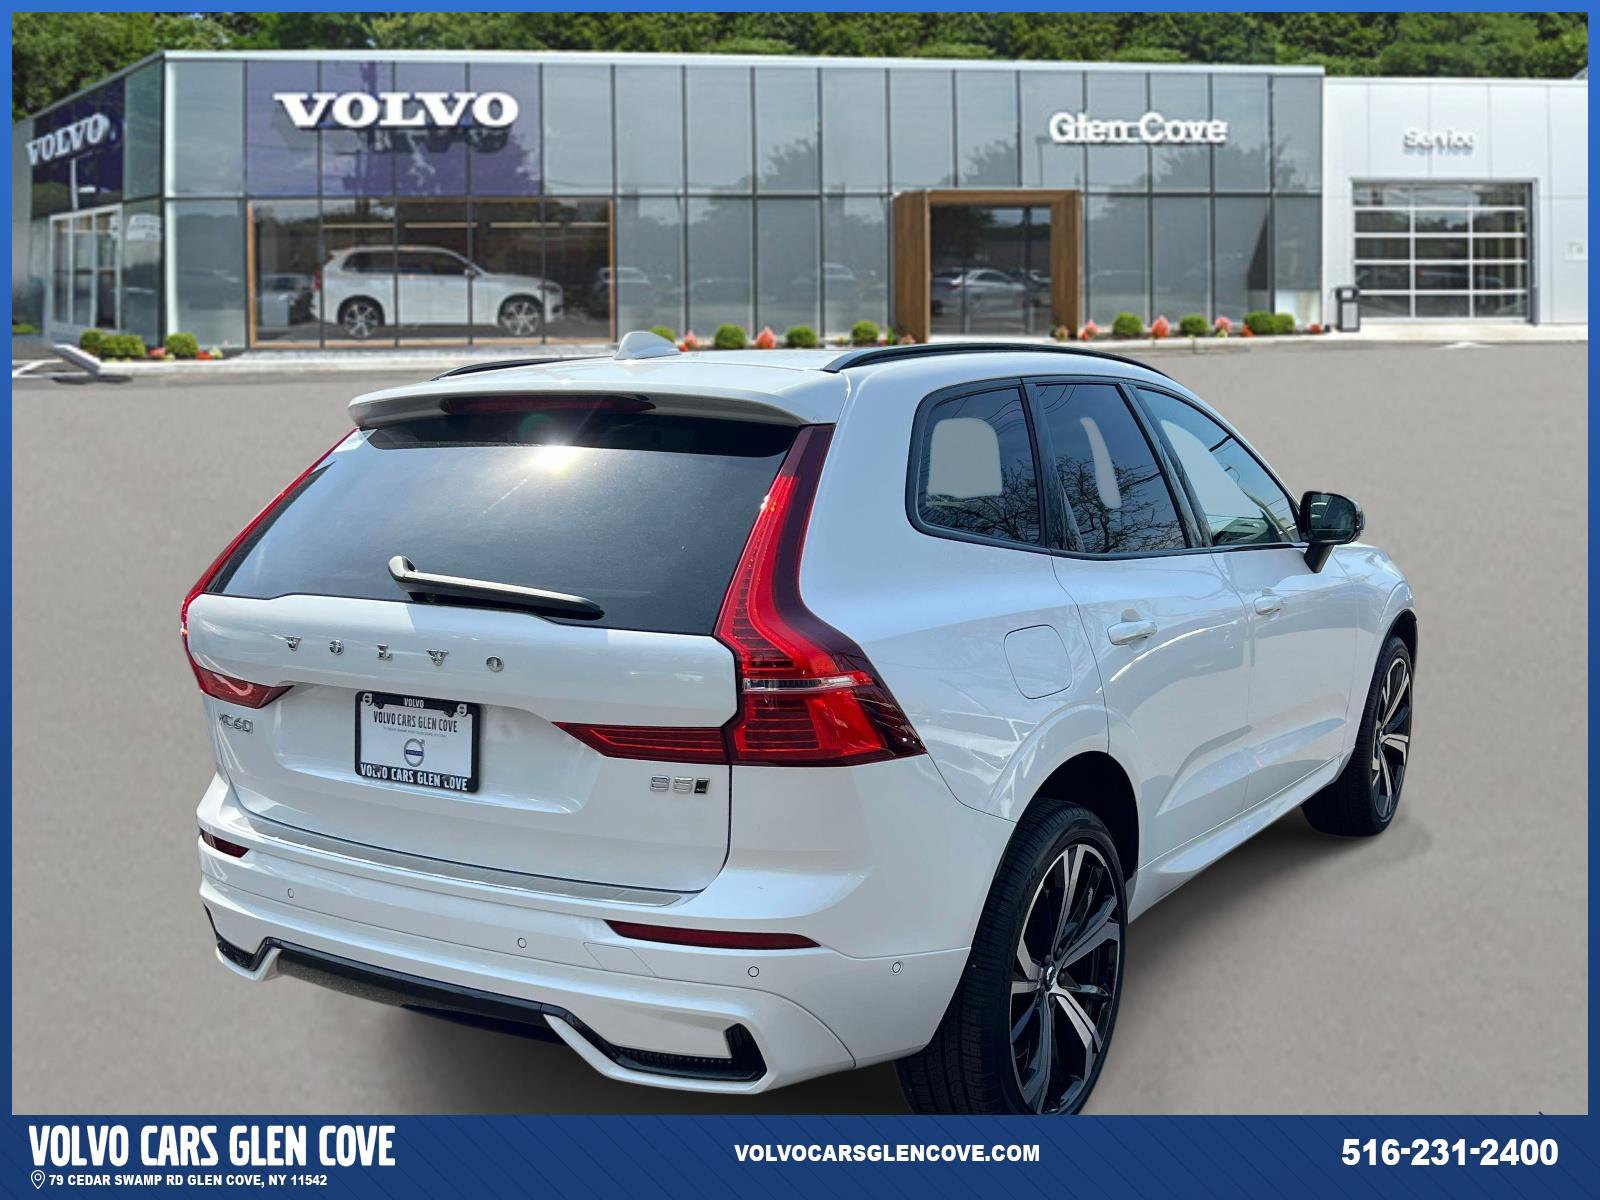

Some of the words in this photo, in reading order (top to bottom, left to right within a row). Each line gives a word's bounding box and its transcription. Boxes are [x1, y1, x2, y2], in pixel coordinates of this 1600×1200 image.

[274, 92, 519, 128] VOLVO
[26, 112, 110, 166] VOLVO
[1049, 112, 1129, 143] Glen
[1138, 112, 1228, 143] Cove
[1402, 128, 1475, 153] Service
[283, 635, 505, 673] VOLVO
[403, 697, 425, 709] VOLVO
[217, 712, 254, 735] XC60
[373, 710, 396, 725] VOLVO
[396, 713, 417, 728] CARS
[418, 716, 437, 731] GLEN
[438, 718, 458, 733] COVE
[391, 768, 414, 783] CARS
[417, 772, 441, 787] GLEN
[649, 774, 694, 794] B5
